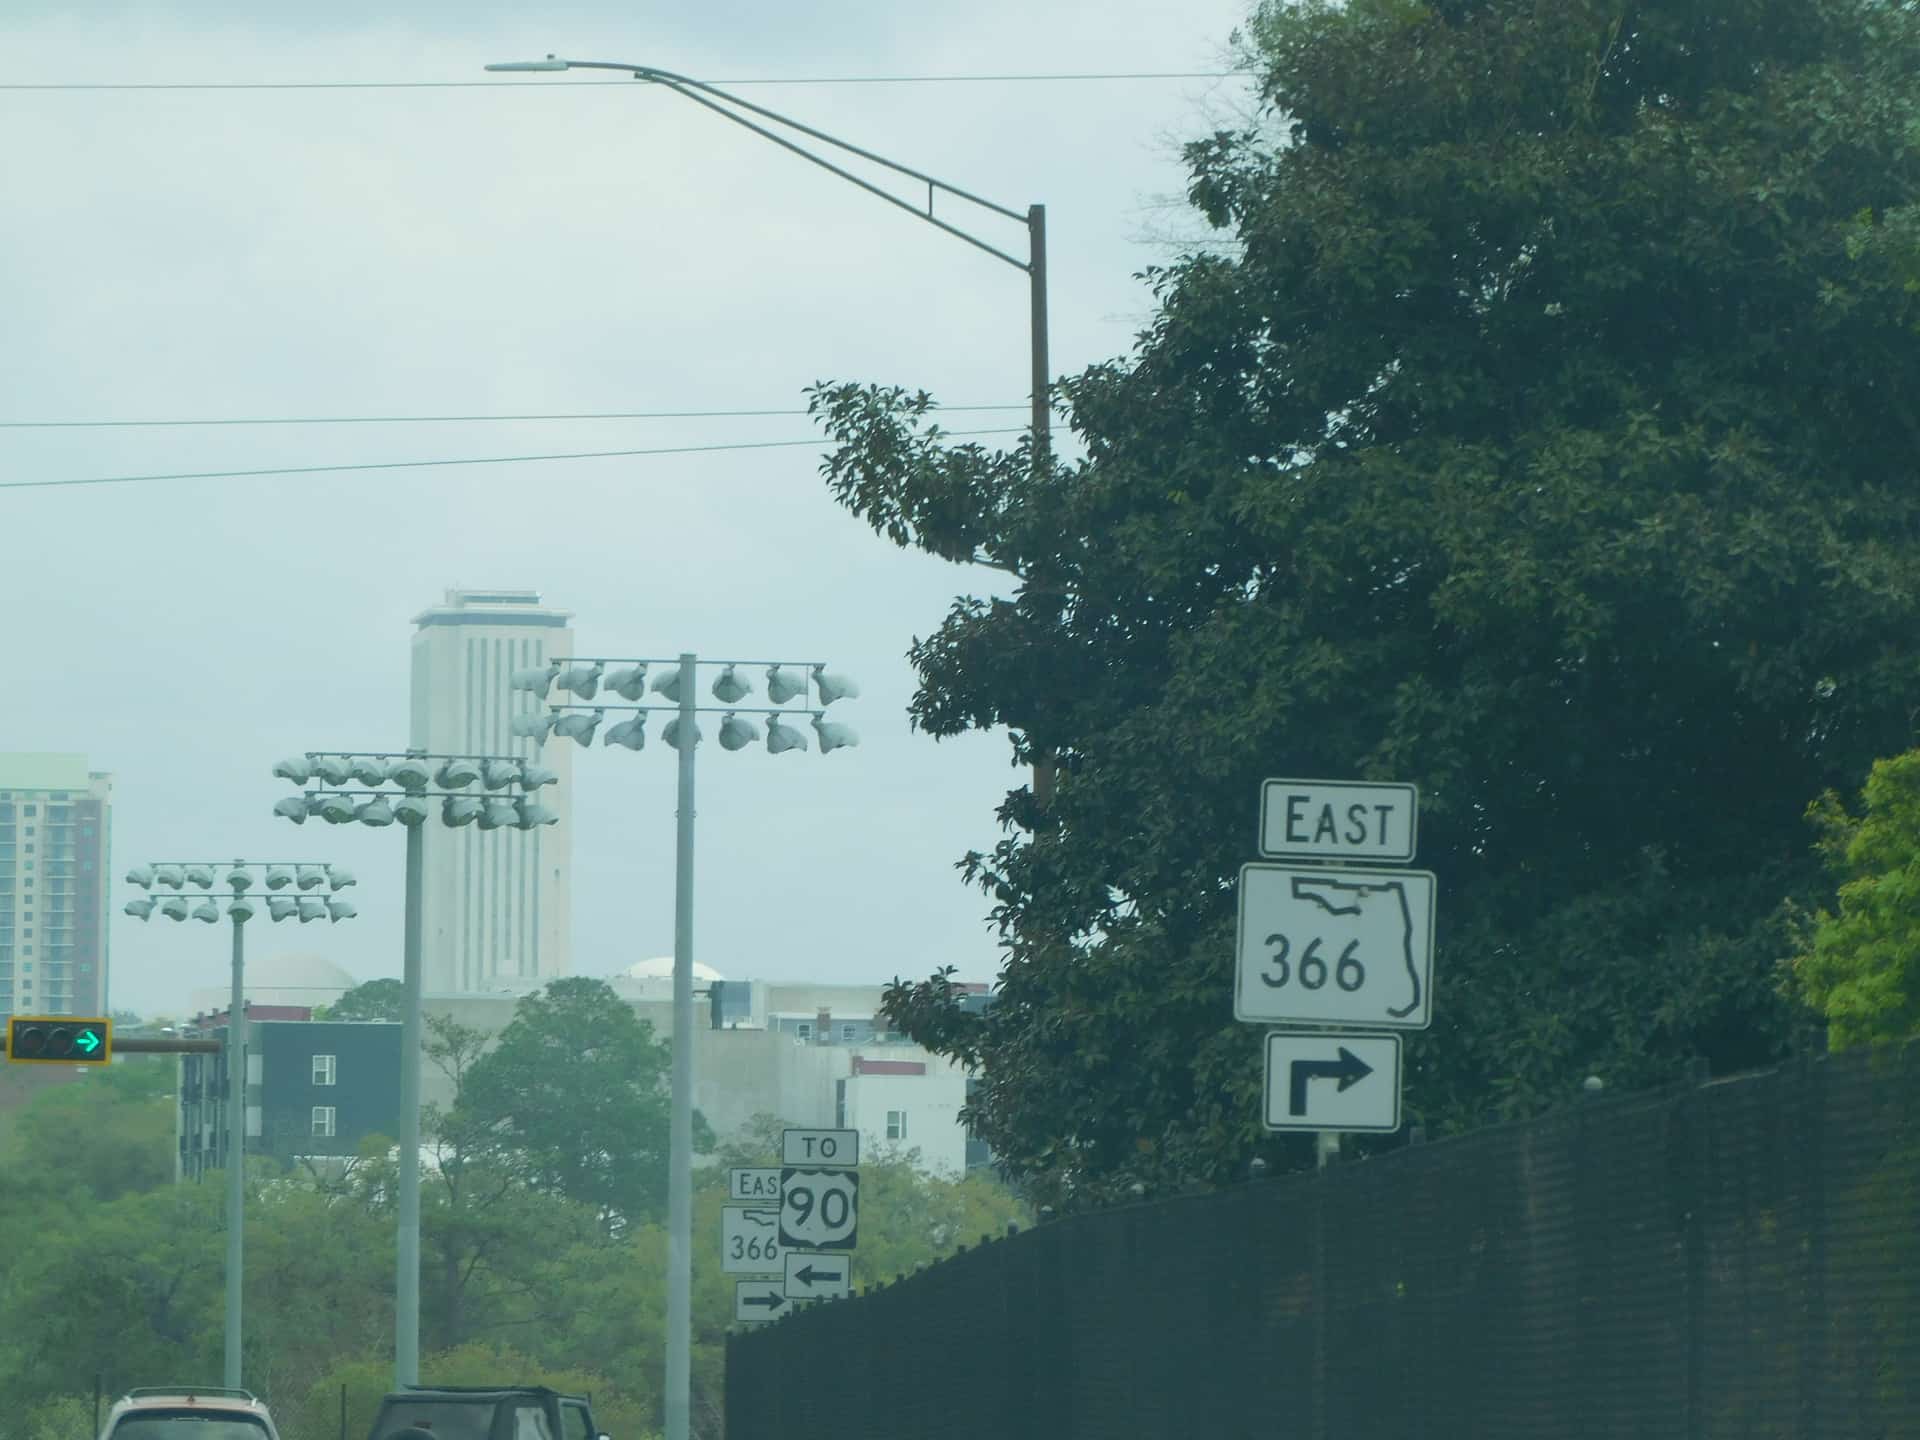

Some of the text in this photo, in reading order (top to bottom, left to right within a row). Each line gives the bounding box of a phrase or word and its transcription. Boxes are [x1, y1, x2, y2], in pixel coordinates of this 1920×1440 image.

[1286, 795, 1395, 845] EAST
[1261, 933, 1366, 992] 366
[801, 1137, 838, 1158] TO
[740, 1173, 777, 1195] EAS
[787, 1187, 849, 1229] 90
[730, 1235, 778, 1260] 366
